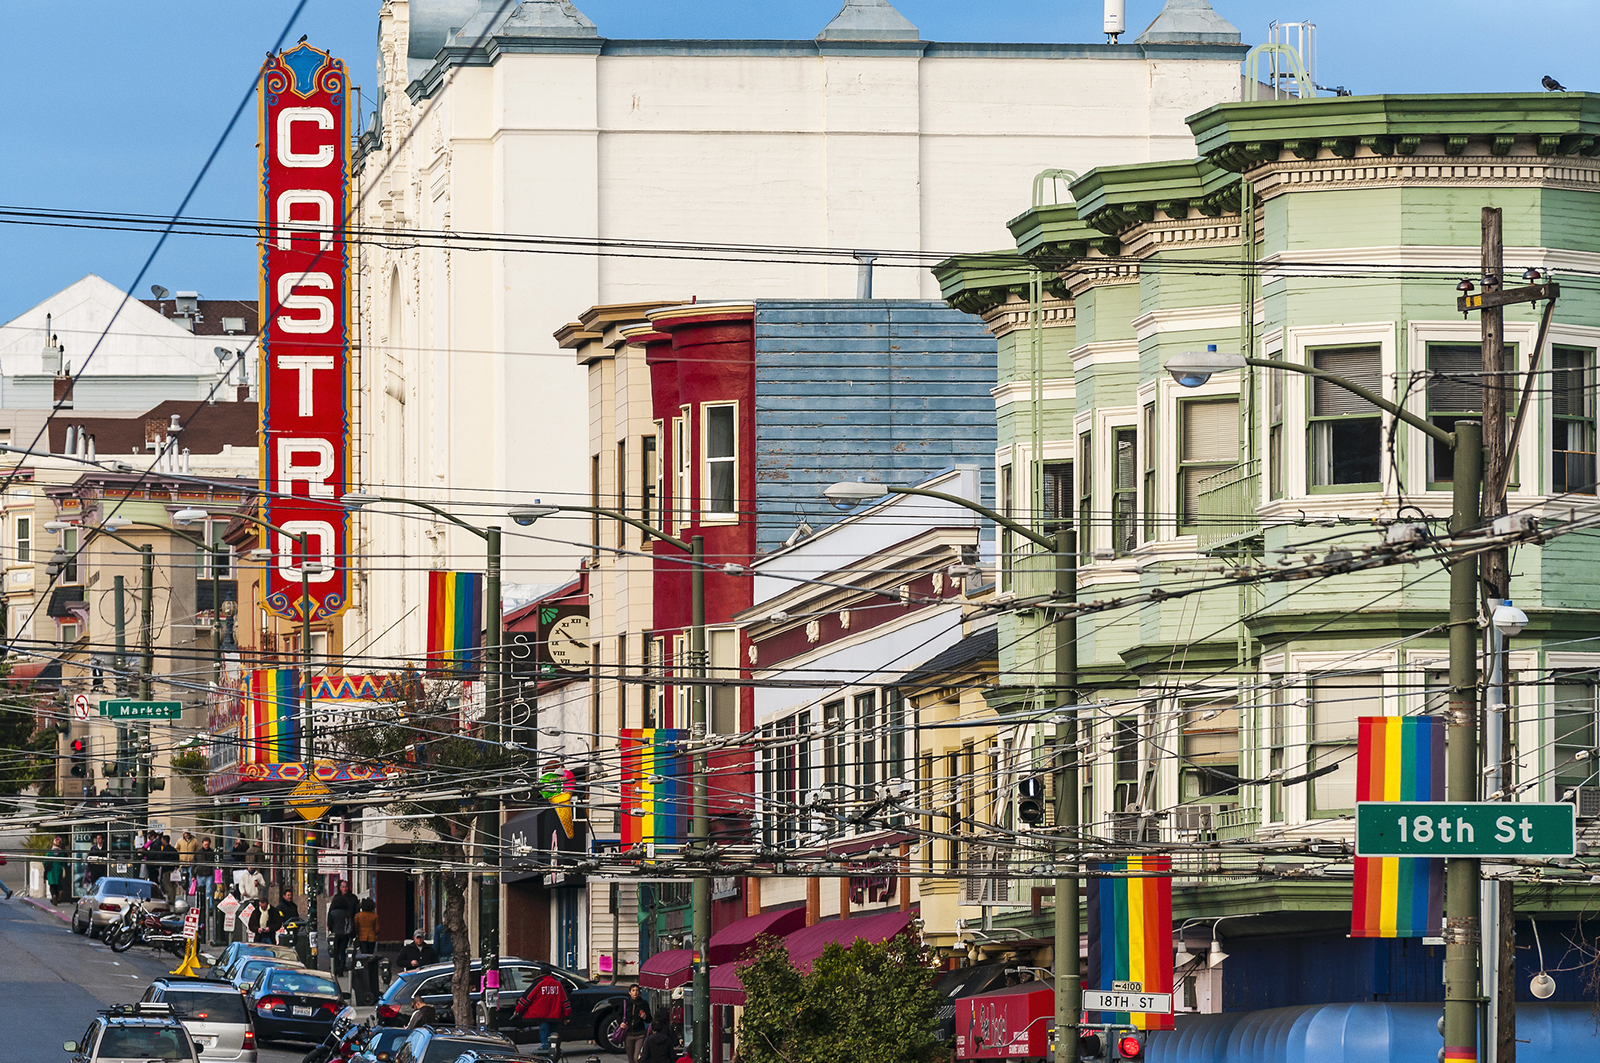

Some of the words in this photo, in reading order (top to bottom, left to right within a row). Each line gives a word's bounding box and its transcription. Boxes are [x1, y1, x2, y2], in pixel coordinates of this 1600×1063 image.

[276, 106, 335, 583] CASTRO
[119, 705, 170, 716] Market
[1397, 815, 1475, 843] 18th
[1494, 815, 1534, 843] St
[541, 985, 559, 995] FUBU
[1121, 982, 1142, 990] 4100
[1099, 995, 1129, 1009] 18TH
[1138, 996, 1156, 1010] ST
